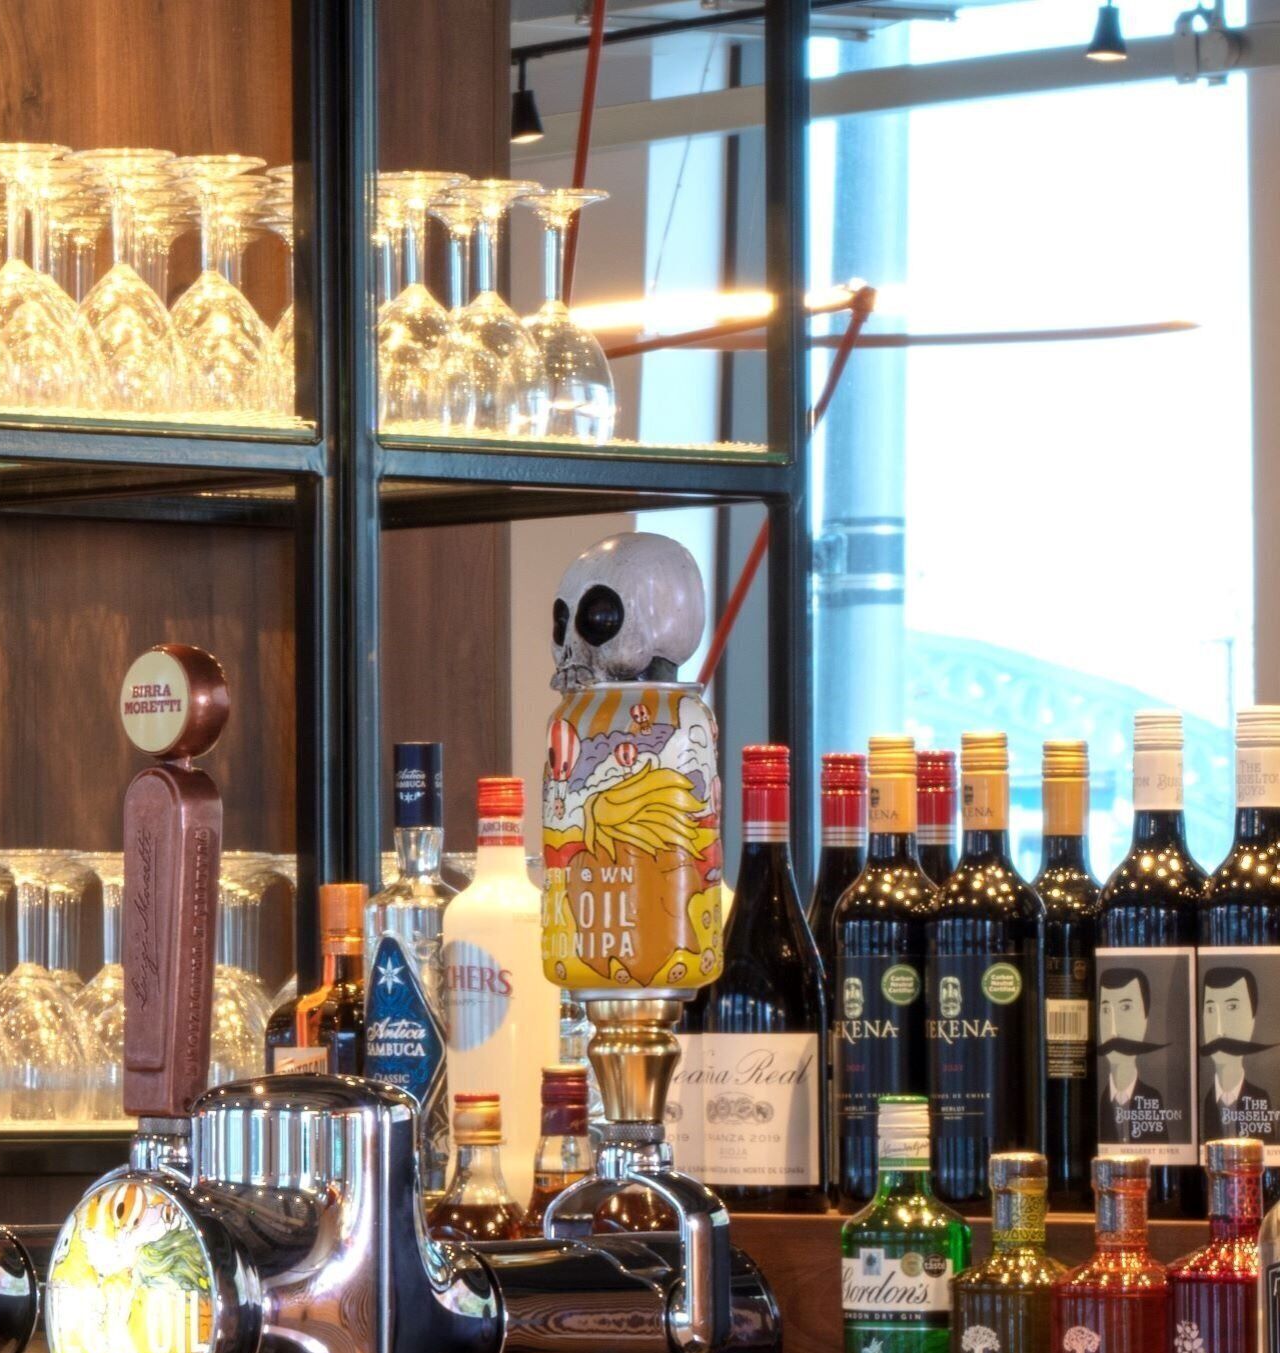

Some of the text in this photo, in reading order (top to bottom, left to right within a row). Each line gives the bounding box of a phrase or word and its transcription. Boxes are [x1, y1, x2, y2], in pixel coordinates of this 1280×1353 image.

[132, 684, 171, 698] BIRRA
[124, 699, 182, 715] MORETTI
[482, 820, 520, 834] ARCHERS
[133, 827, 152, 934] Moretti
[580, 891, 636, 928] OIL
[589, 931, 635, 958] IPA
[366, 1018, 426, 1041] Antica
[833, 1018, 899, 1045] EKENA
[736, 1049, 814, 1085] Real
[1135, 1095, 1160, 1110] THE
[1242, 1096, 1269, 1110] THE
[1115, 1107, 1183, 1124] BUSSELTON
[750, 1133, 781, 1143] 2019
[1131, 1121, 1164, 1138] BOYS
[1241, 1121, 1272, 1138] BOYS
[874, 1311, 893, 1319] DRY
[901, 1311, 921, 1319] GIN
